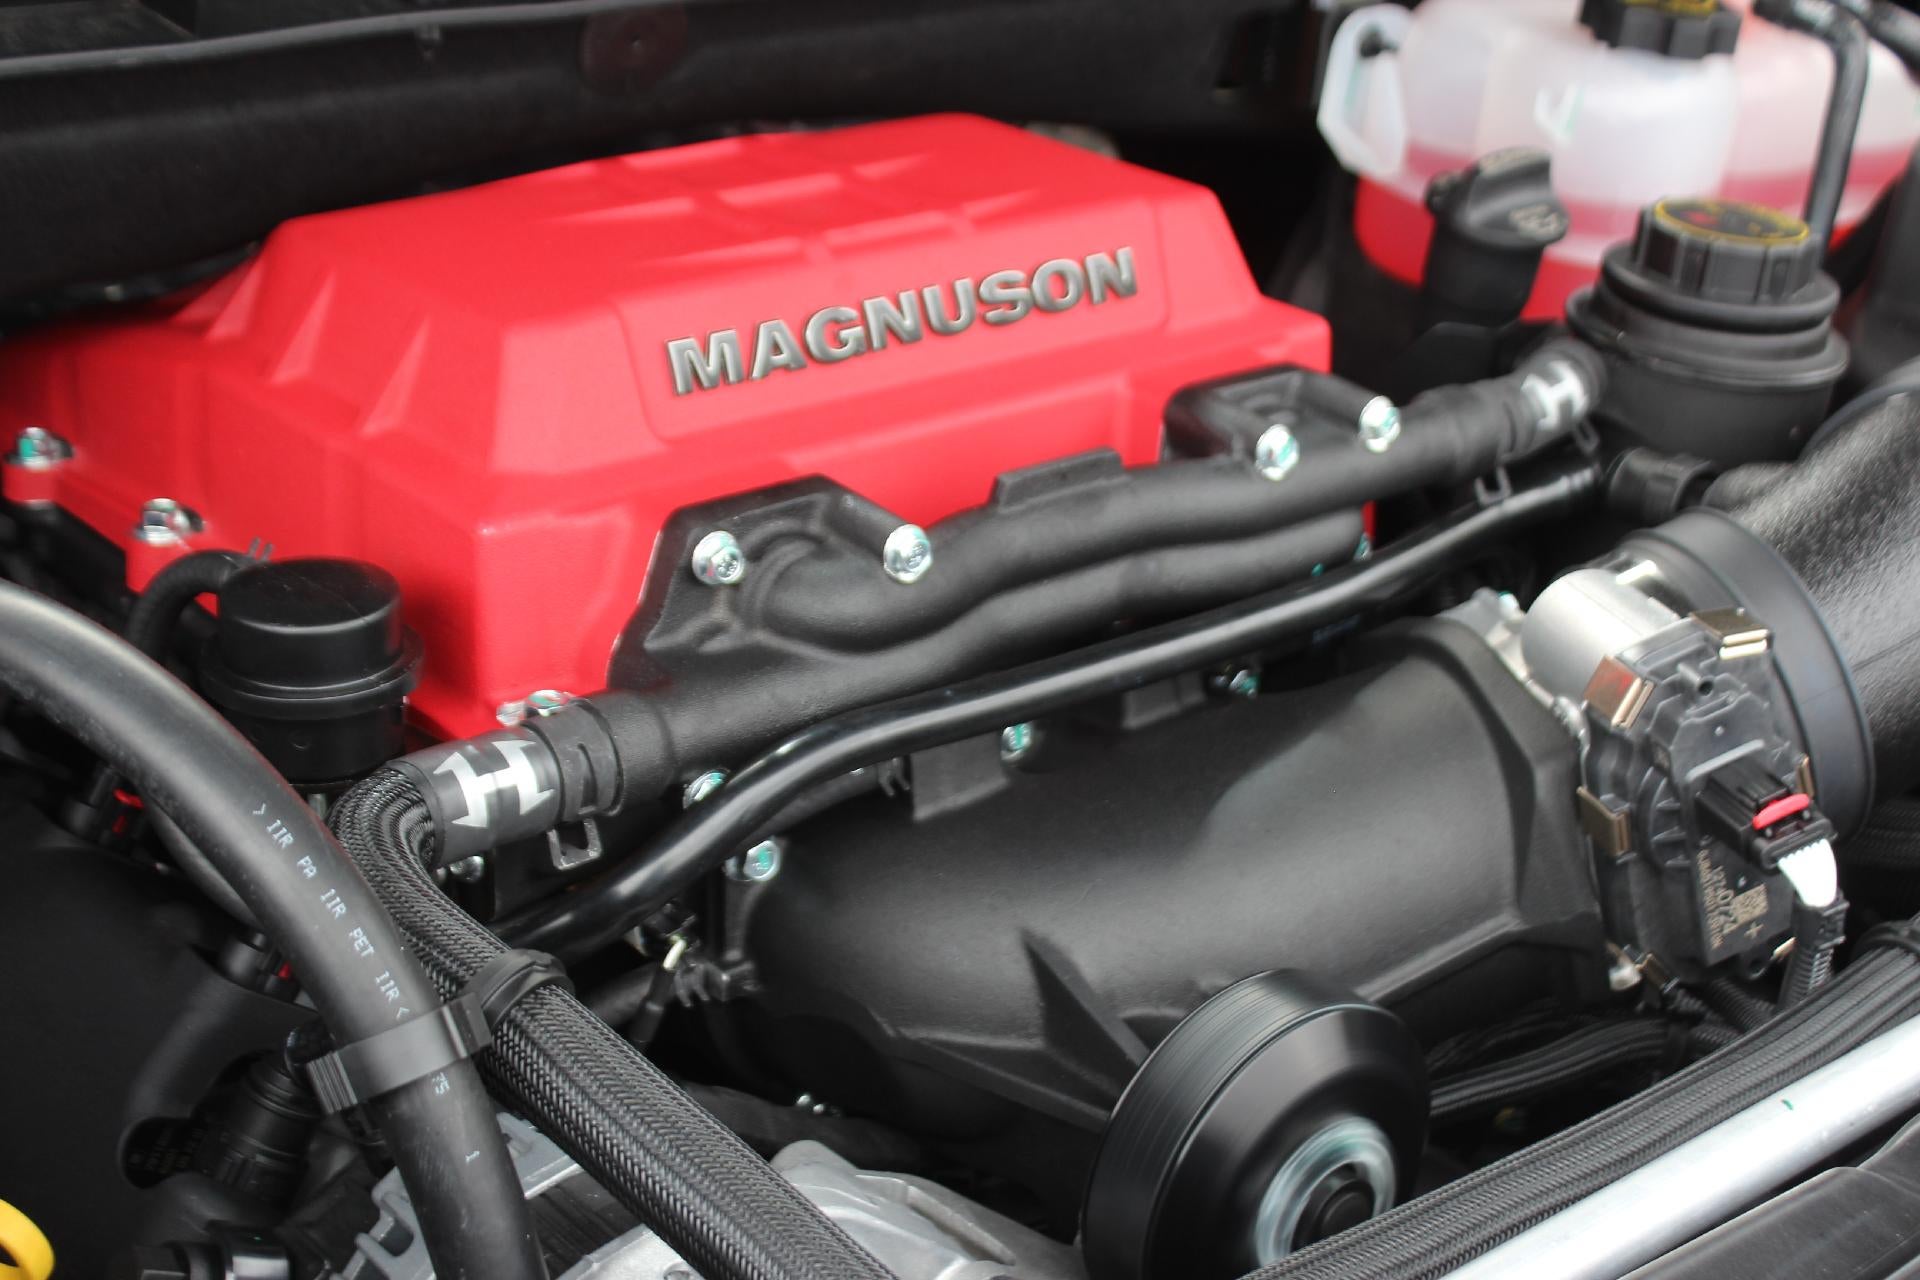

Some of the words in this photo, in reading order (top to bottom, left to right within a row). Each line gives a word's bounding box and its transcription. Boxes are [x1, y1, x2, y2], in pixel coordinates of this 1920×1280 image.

[666, 246, 1138, 395] MAGNUSON
[297, 855, 317, 879] PA
[349, 927, 375, 957] PET
